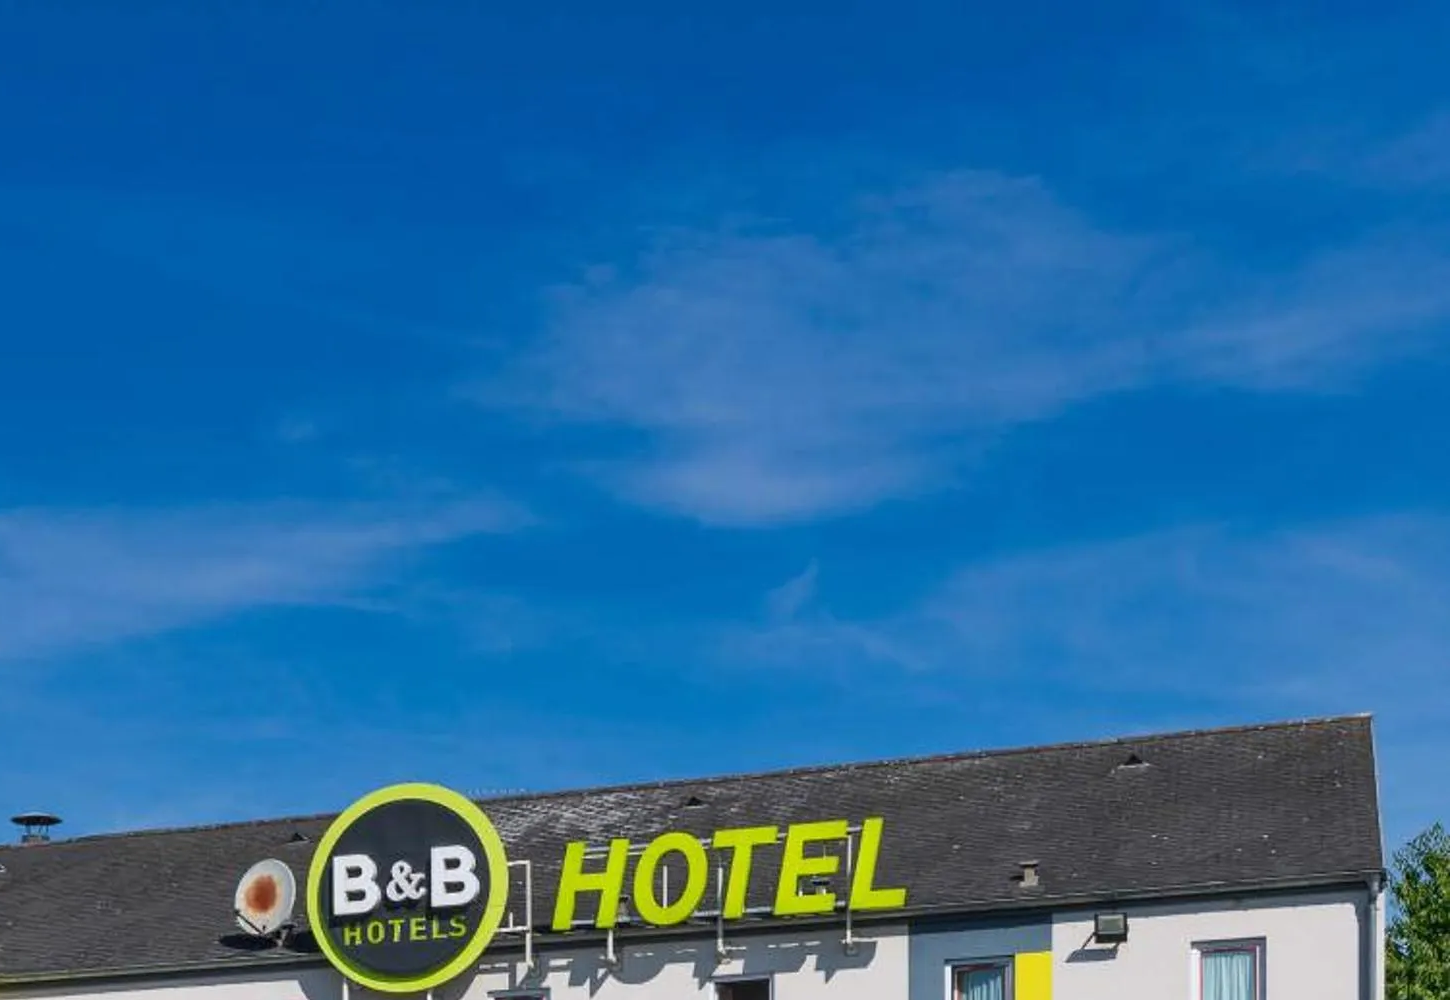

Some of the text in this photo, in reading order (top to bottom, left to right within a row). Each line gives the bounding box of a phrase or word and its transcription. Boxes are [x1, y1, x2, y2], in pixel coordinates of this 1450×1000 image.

[333, 845, 481, 916] B&B
[552, 816, 907, 931] HOTEL
[344, 915, 467, 946] HOTELS
